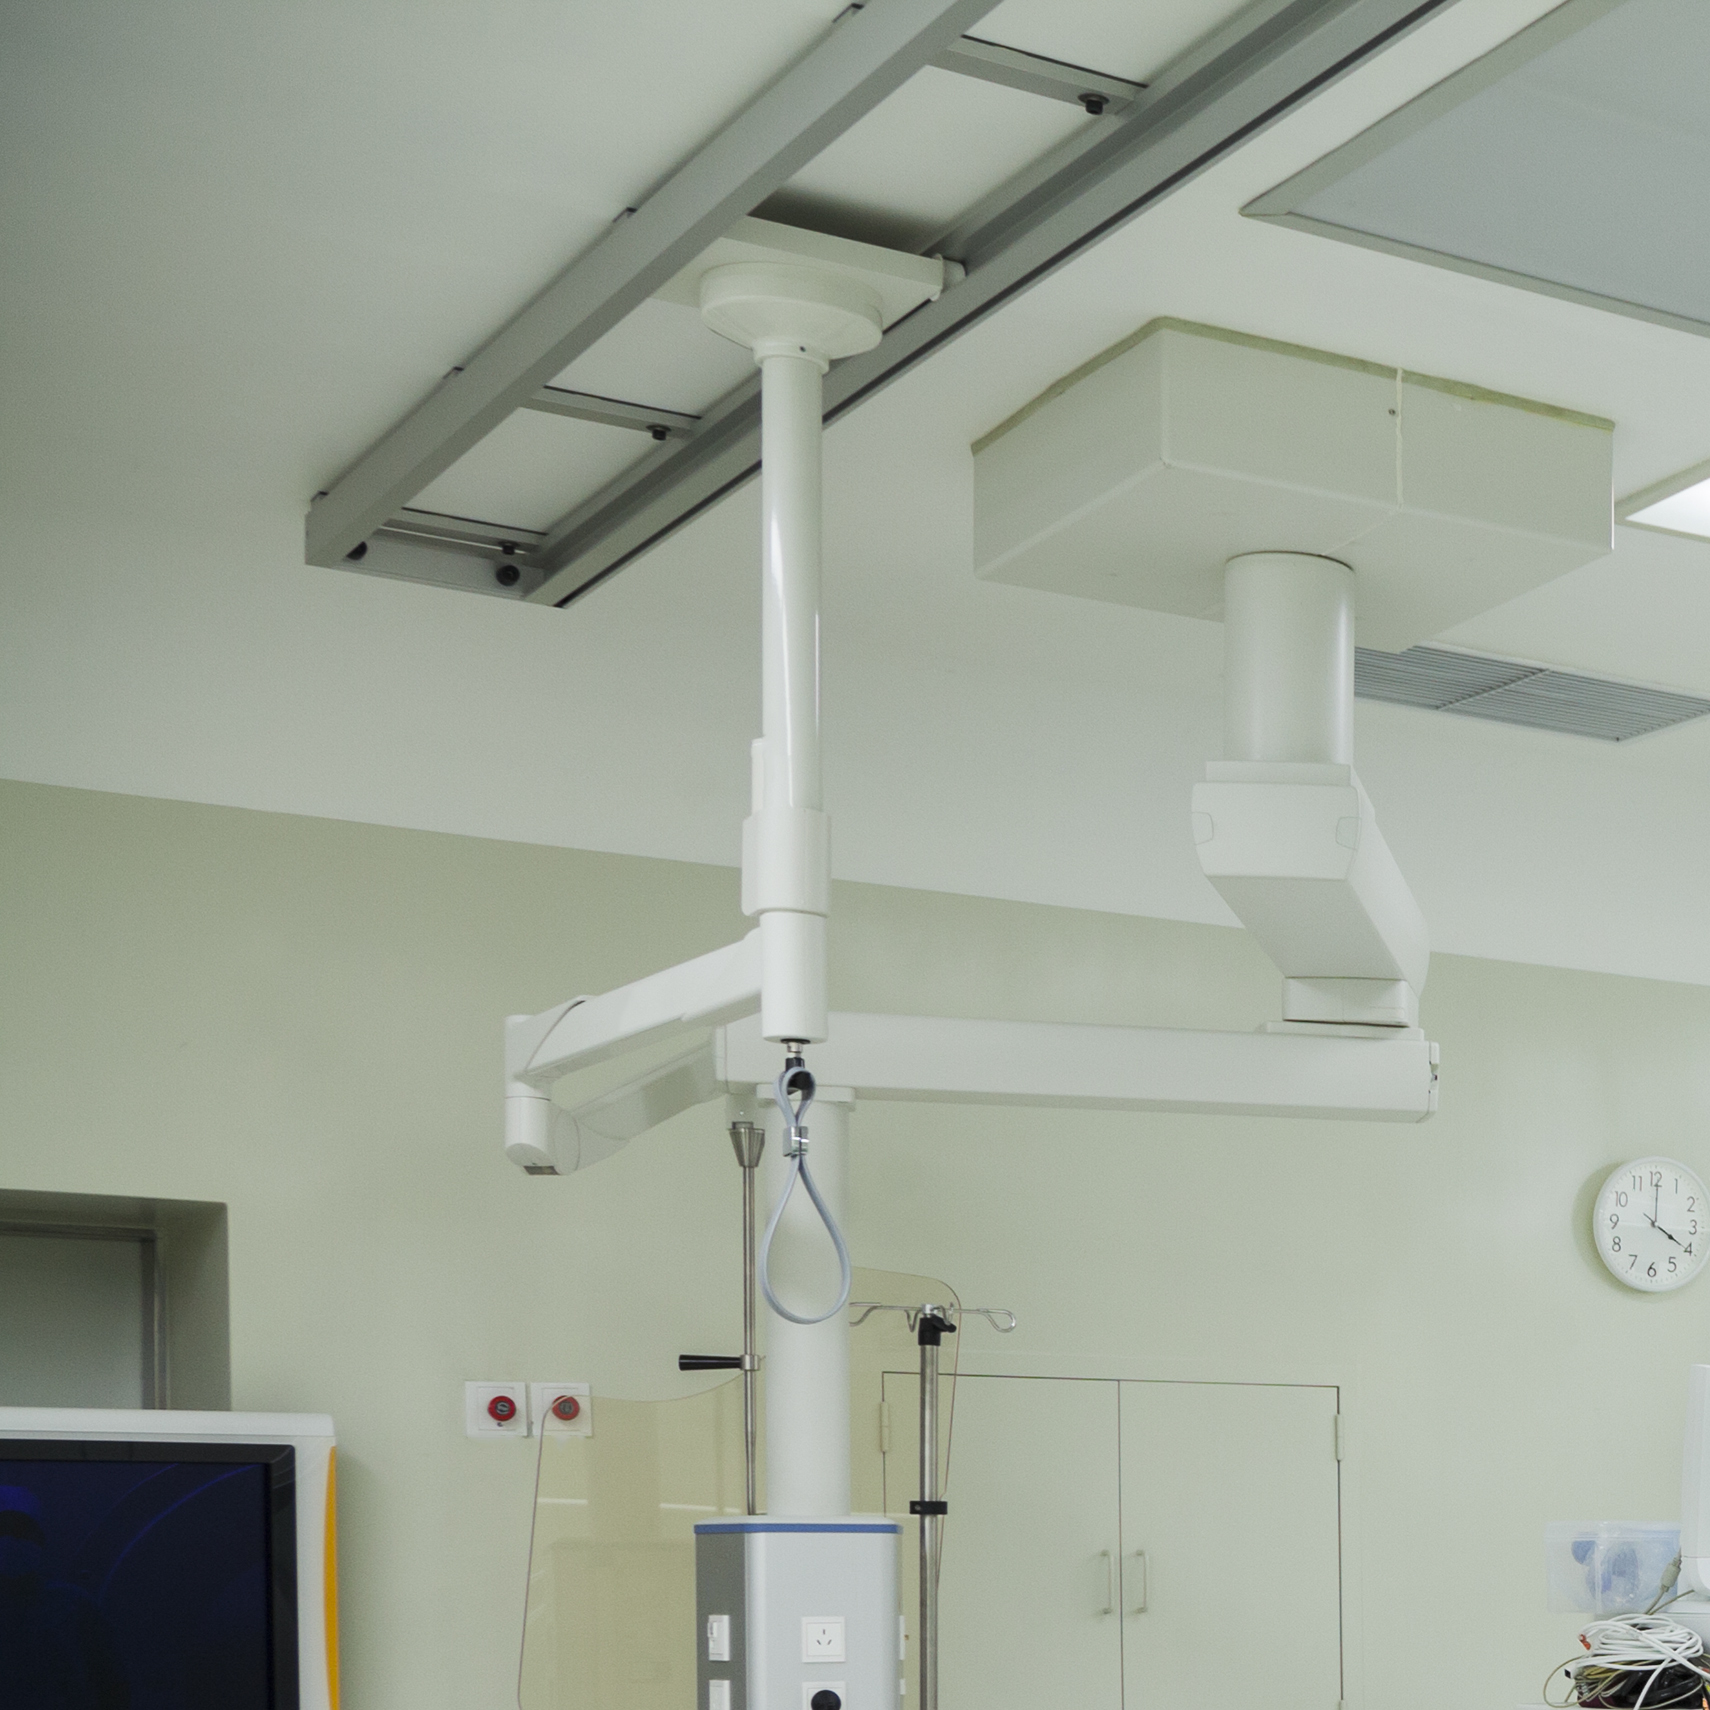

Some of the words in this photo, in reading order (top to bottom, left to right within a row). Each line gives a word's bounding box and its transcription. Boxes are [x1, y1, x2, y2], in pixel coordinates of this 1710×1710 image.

[1632, 1175, 1642, 1192] 11
[1650, 1171, 1663, 1187] 12
[1674, 1178, 1678, 1194] 1
[1615, 1190, 1628, 1208] 10
[1687, 1196, 1695, 1212] 2
[1609, 1213, 1619, 1230] 9
[1688, 1219, 1697, 1235] 3
[1611, 1236, 1621, 1253] 8
[1683, 1241, 1693, 1256] 4
[1628, 1254, 1638, 1270] 7
[1647, 1261, 1657, 1278] 6
[1667, 1256, 1677, 1273] 5
